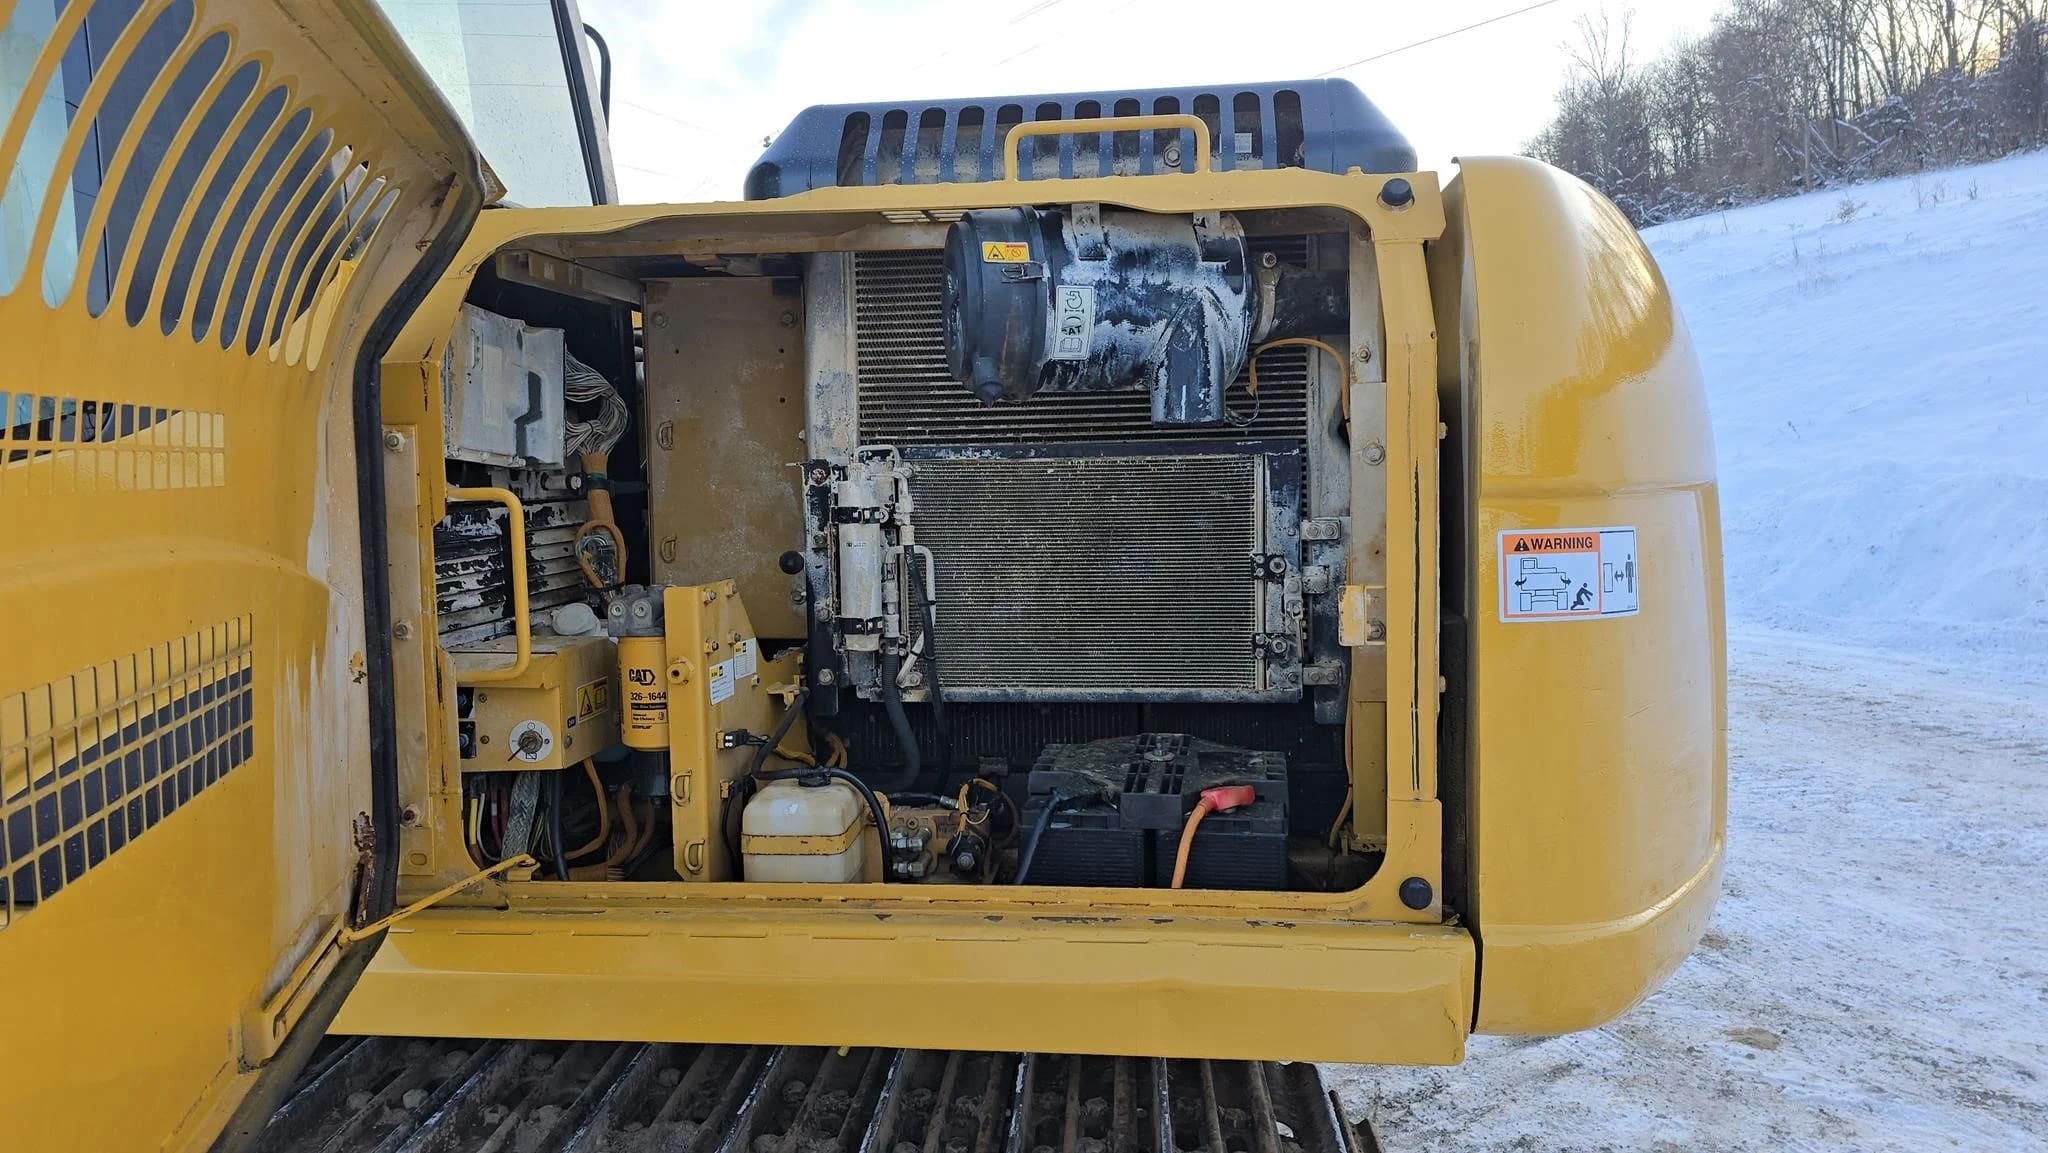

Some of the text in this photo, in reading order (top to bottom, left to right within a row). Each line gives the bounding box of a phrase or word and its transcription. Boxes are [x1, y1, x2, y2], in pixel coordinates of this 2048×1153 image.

[1530, 536, 1593, 551] WARNING
[629, 668, 651, 683] CAT
[630, 692, 667, 701] 326-1644
